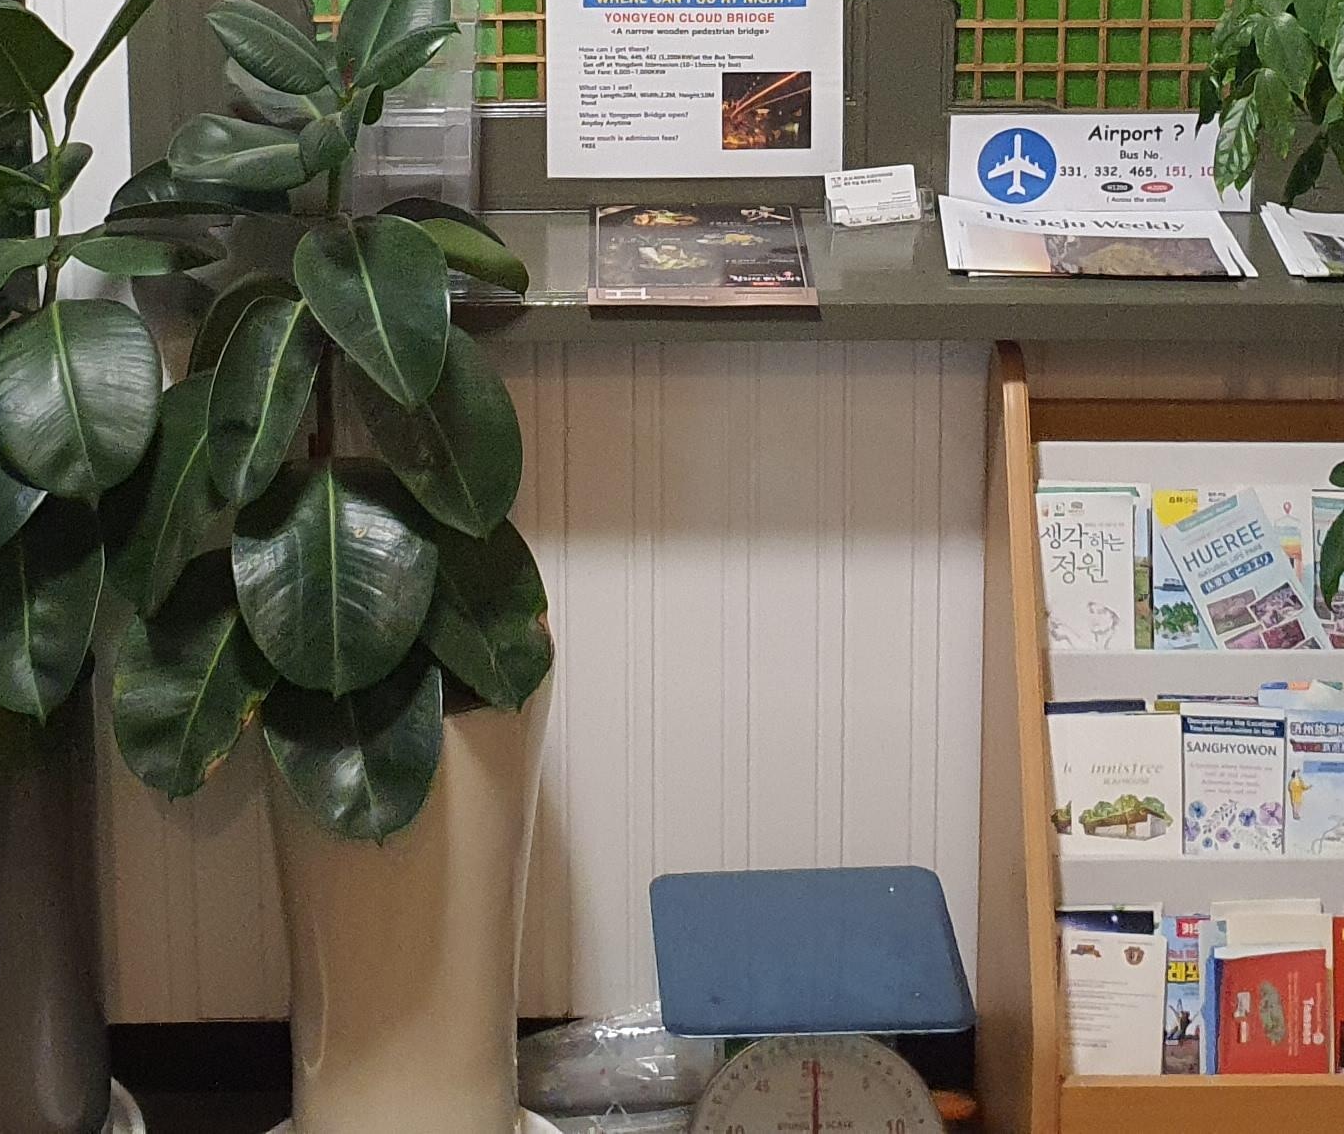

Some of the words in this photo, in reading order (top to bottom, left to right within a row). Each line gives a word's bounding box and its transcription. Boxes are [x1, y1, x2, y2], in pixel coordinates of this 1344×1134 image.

[605, 13, 674, 23] YONGYEON
[679, 13, 722, 23] CLOUD
[727, 13, 775, 23] BRIDGE
[692, 28, 734, 37] pedestrian
[1088, 125, 1163, 149] Airport
[1173, 125, 1185, 141] ?
[1120, 150, 1139, 160] Bus
[1143, 150, 1163, 160] No.
[1060, 167, 1087, 179] 331,
[1094, 167, 1121, 179] 332,
[1129, 167, 1156, 179] 465,
[1165, 167, 1192, 179] 151,
[1200, 167, 1214, 177] 10
[980, 210, 1029, 225] The
[1034, 216, 1086, 231] Jeju
[1092, 219, 1185, 232] Weekly
[1041, 523, 1125, 551] 생각하는
[1182, 520, 1265, 572] HUEREE
[1051, 550, 1108, 584] 정원
[1186, 742, 1277, 756] SANGHYOWON
